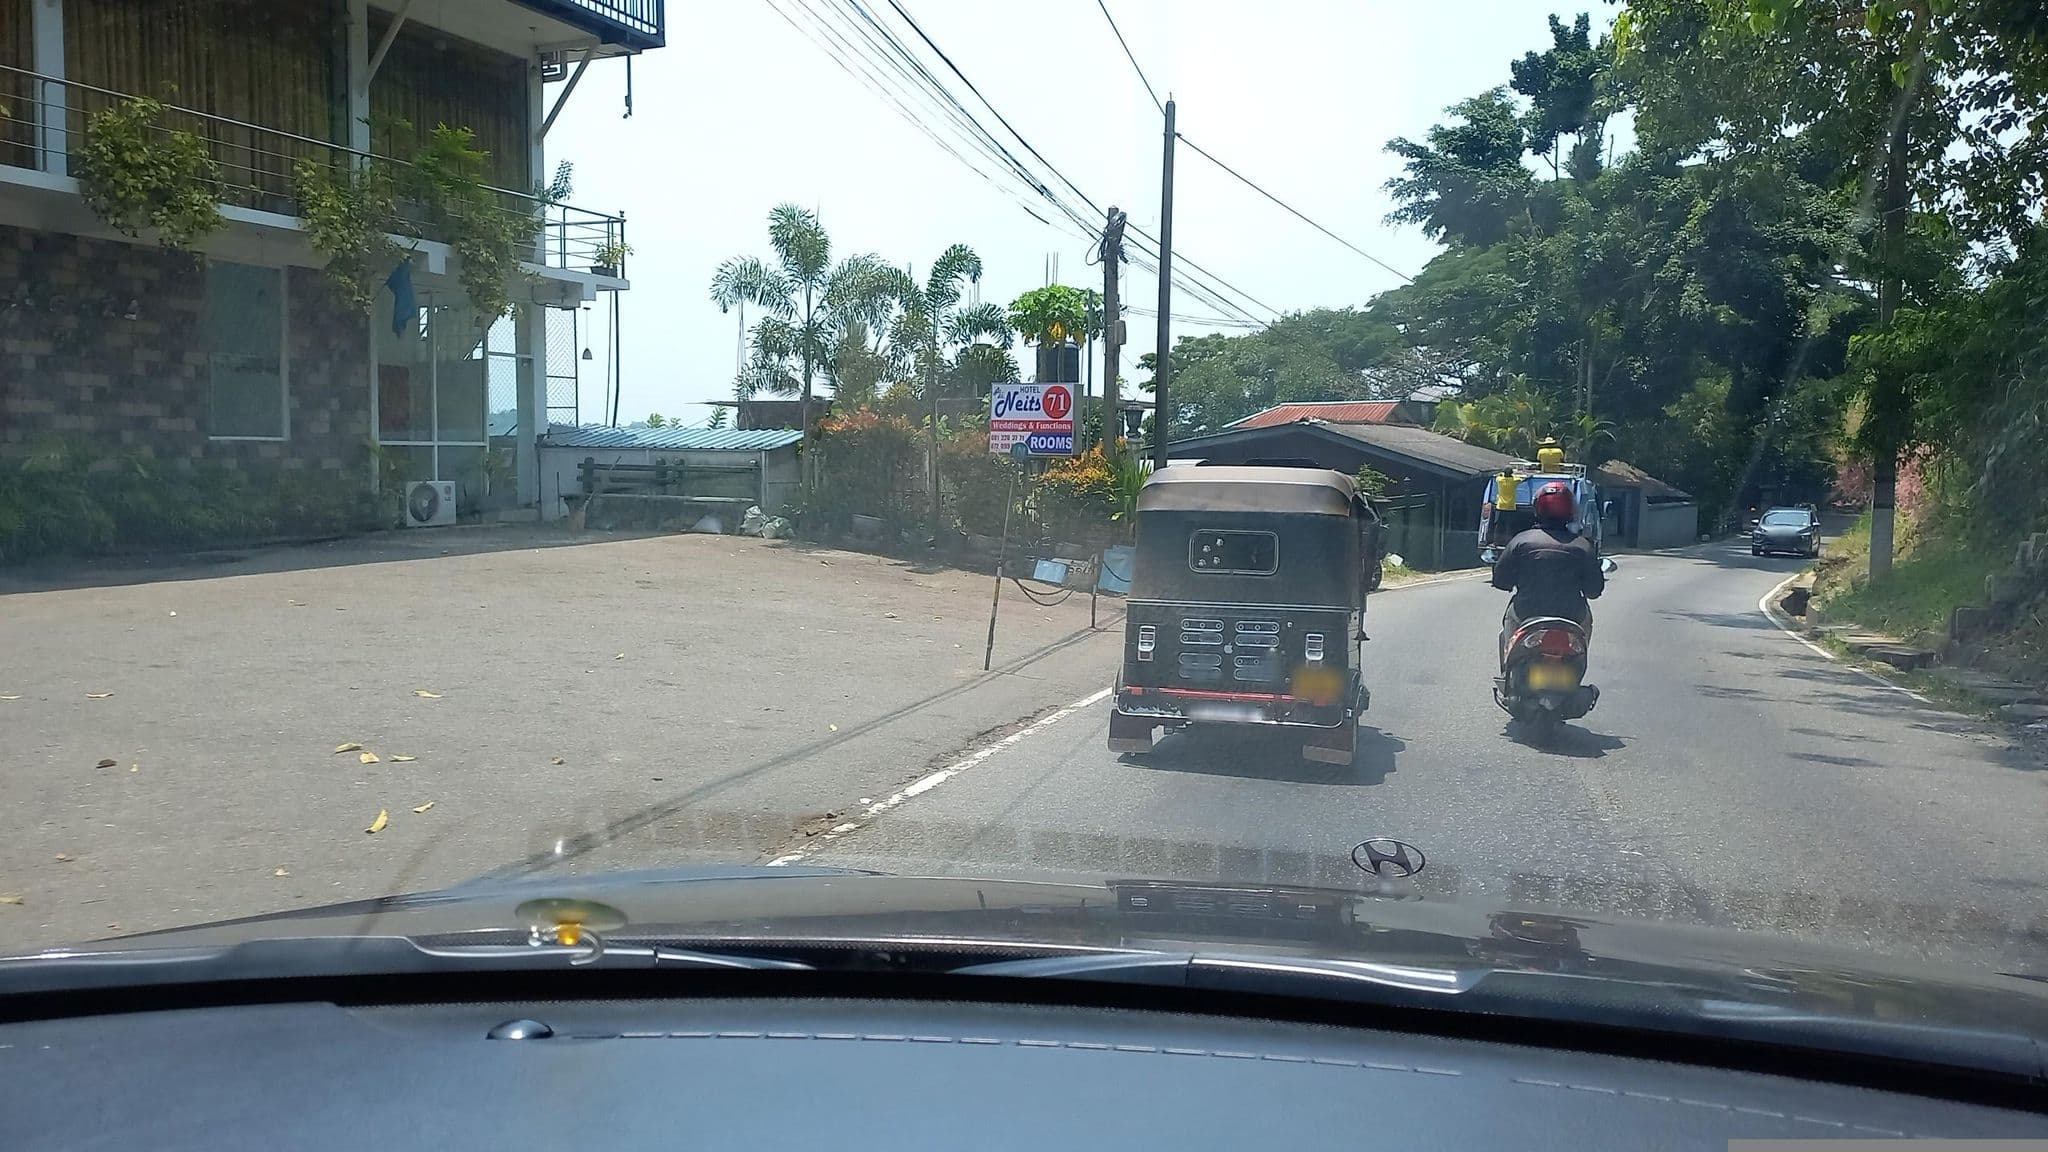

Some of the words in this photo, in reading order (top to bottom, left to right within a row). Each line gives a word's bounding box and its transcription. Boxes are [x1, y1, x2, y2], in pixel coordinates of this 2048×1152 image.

[1020, 386, 1041, 394] HOTEL
[995, 391, 1041, 418] Neits
[1047, 393, 1067, 411] 71
[992, 422, 1027, 431] Weddings
[1028, 422, 1035, 430] &
[1036, 422, 1072, 430] Functions
[1030, 436, 1073, 450] ROOMS
